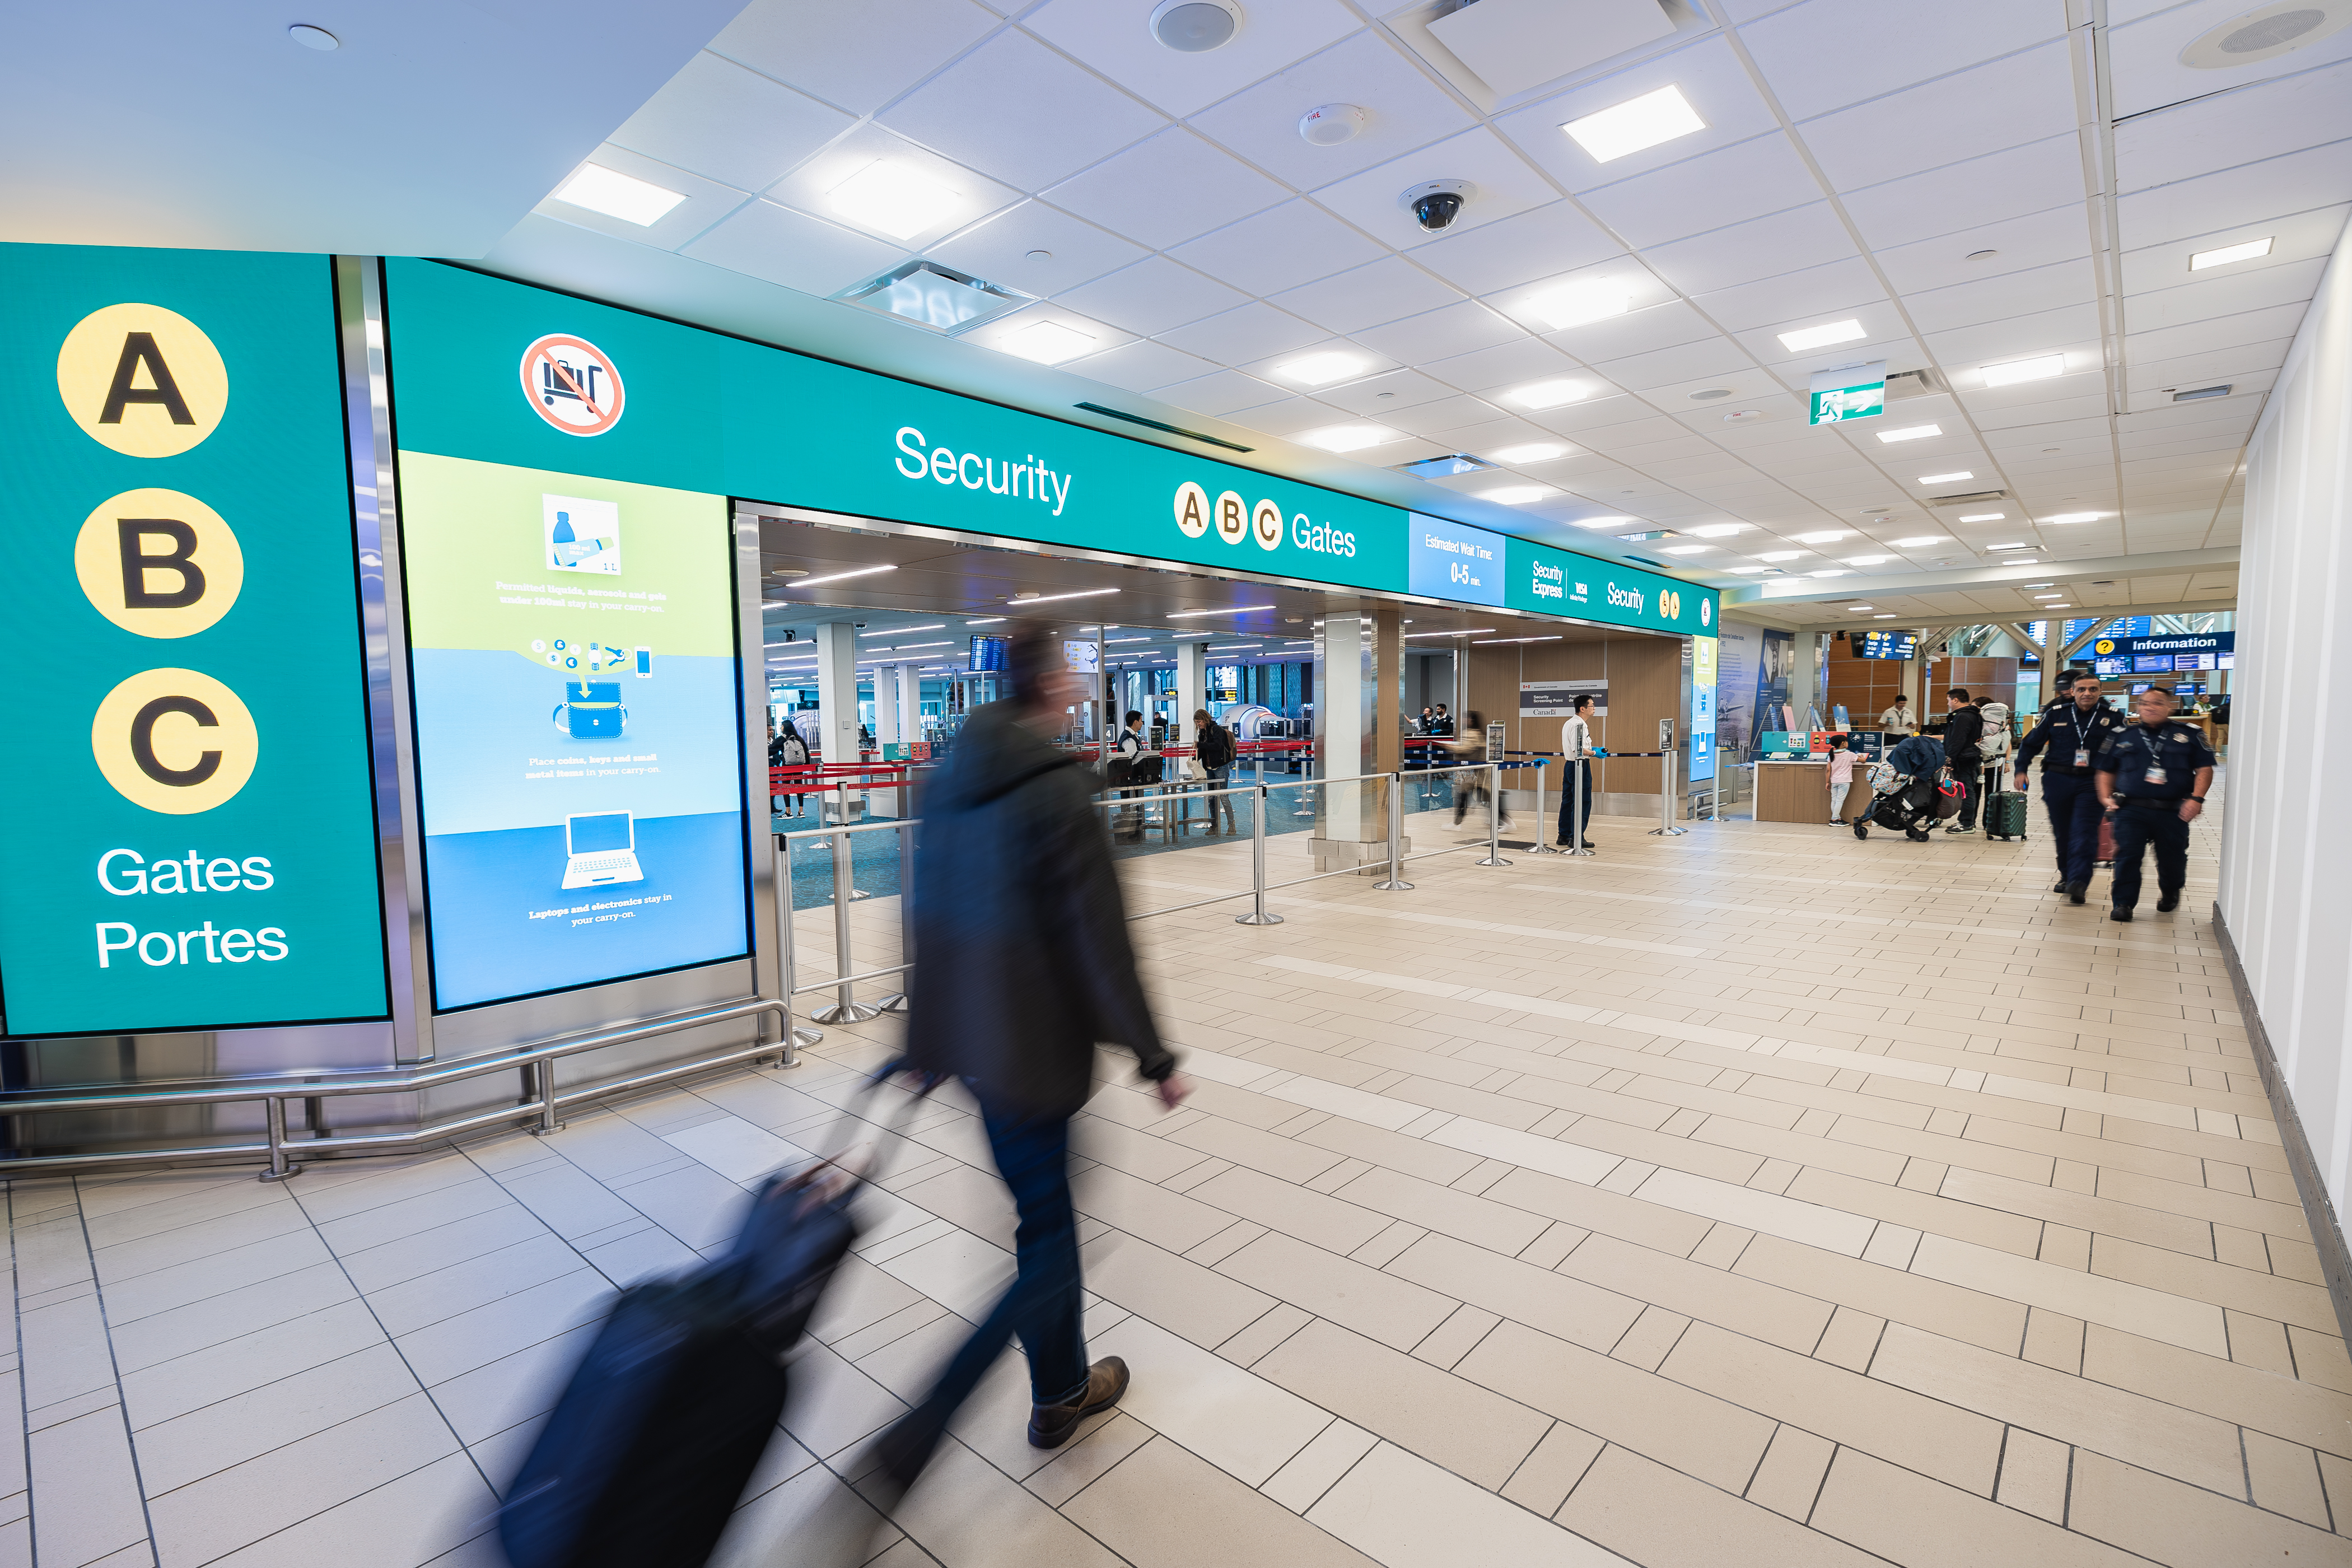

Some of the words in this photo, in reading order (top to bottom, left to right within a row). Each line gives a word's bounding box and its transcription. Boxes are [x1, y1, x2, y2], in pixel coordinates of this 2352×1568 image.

[1308, 111, 1320, 123] FIRE
[99, 332, 196, 425] A
[895, 426, 1072, 516] Security
[1182, 491, 1202, 528] A
[1224, 499, 1240, 533] B
[1259, 508, 1276, 542] C
[1292, 513, 1355, 557] Gates
[1425, 534, 1459, 553] Estimated
[1460, 542, 1474, 557] Wait
[1476, 545, 1492, 561] Time:
[117, 519, 206, 609] B
[1451, 562, 1469, 585] 0-5
[1470, 576, 1481, 586] min.
[1533, 561, 1563, 585] Security
[496, 581, 545, 592] Permitted
[547, 585, 585, 596] liquids,
[587, 589, 627, 598] aerosols
[648, 592, 666, 601] gels
[1533, 578, 1562, 599] Express
[1575, 582, 1588, 595] VISA
[1607, 581, 1644, 615] Security
[499, 596, 532, 605] under
[534, 597, 566, 606] 100ml
[567, 600, 587, 609] stay
[588, 600, 599, 609] in
[624, 604, 664, 613] carry-on.
[2132, 637, 2216, 650] Information
[130, 696, 222, 787] C
[529, 758, 555, 766] Place
[557, 757, 587, 765] coins,
[589, 755, 612, 765] keys
[613, 754, 631, 763] and
[633, 754, 657, 762] small
[525, 770, 554, 779] metal
[556, 769, 584, 778] items
[598, 768, 619, 777] your
[621, 767, 661, 775] carry-on.
[97, 848, 274, 896] Gates
[529, 908, 569, 920] Laptops
[571, 904, 589, 914] and
[591, 898, 642, 911] electronics
[643, 895, 661, 904] stay
[662, 893, 673, 902] in
[571, 917, 593, 927] your
[595, 912, 636, 922] carry-on.
[96, 921, 289, 969] Portes
